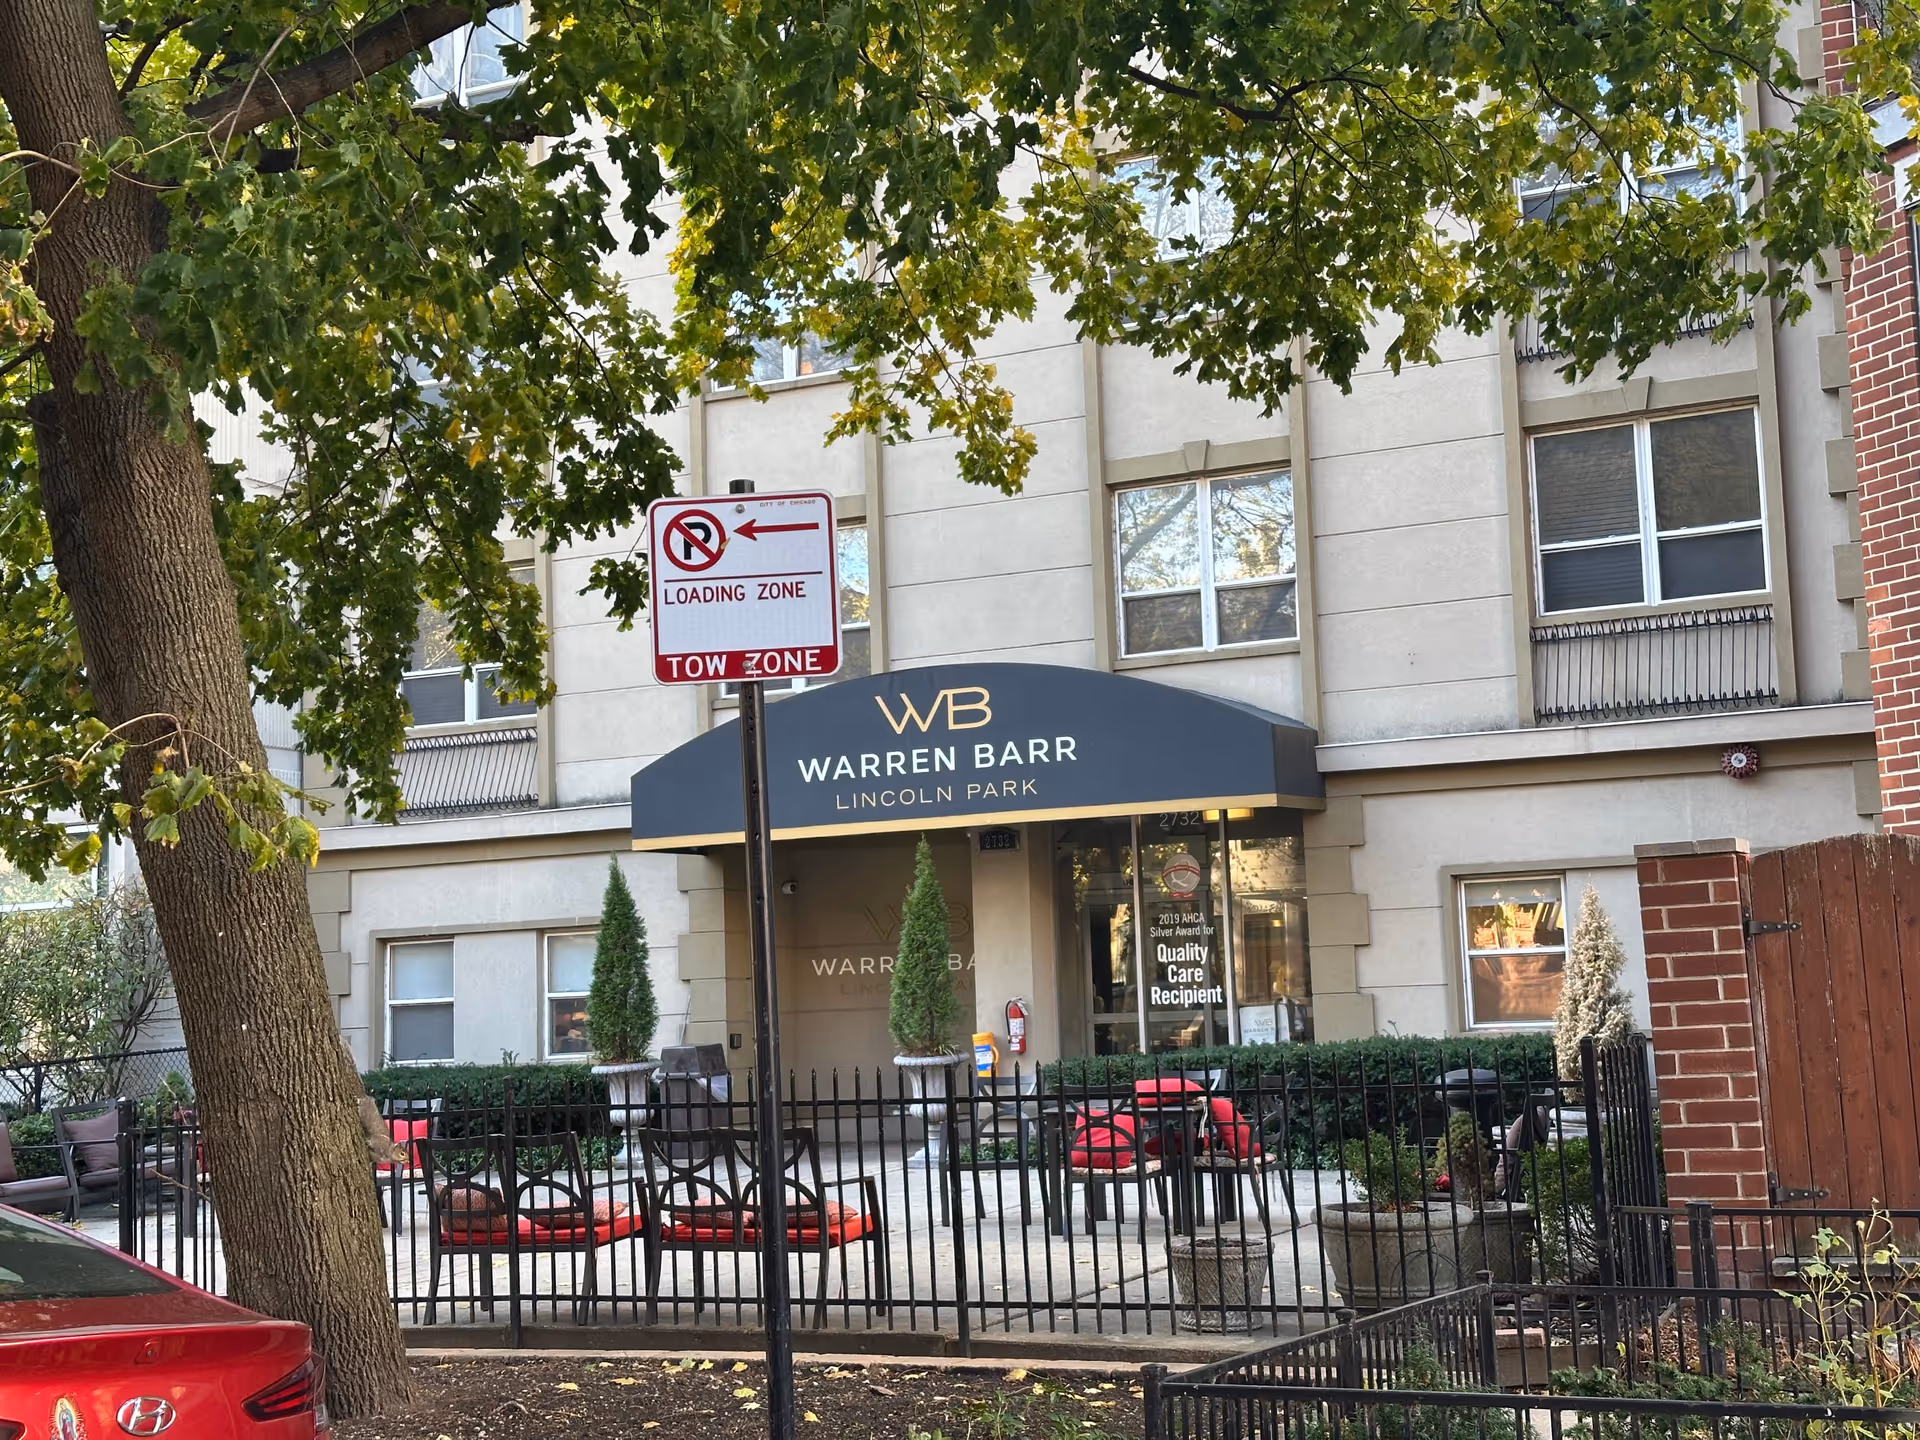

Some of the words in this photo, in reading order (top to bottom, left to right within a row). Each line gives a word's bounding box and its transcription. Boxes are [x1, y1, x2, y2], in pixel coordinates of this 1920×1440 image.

[664, 584, 745, 605] LOADING
[757, 581, 806, 600] ZONE
[666, 654, 727, 678] TOW
[744, 649, 822, 675] ZONE
[874, 686, 993, 735] WB
[797, 746, 956, 783] WARREN
[974, 736, 1078, 769] BARR
[836, 786, 952, 810] LINCOLN
[967, 778, 1038, 800] PARK
[1159, 811, 1200, 827] 2732
[985, 834, 1010, 849] 2732
[1158, 913, 1180, 925] 2019
[1182, 912, 1205, 924] AHCA
[1150, 926, 1173, 937] Silver
[1175, 925, 1200, 936] Award
[1203, 924, 1214, 935] for
[811, 955, 895, 976] WARR
[948, 953, 976, 971] BA
[1157, 942, 1208, 965] Quality
[1167, 964, 1204, 983] Care
[1150, 985, 1223, 1008] Recipient
